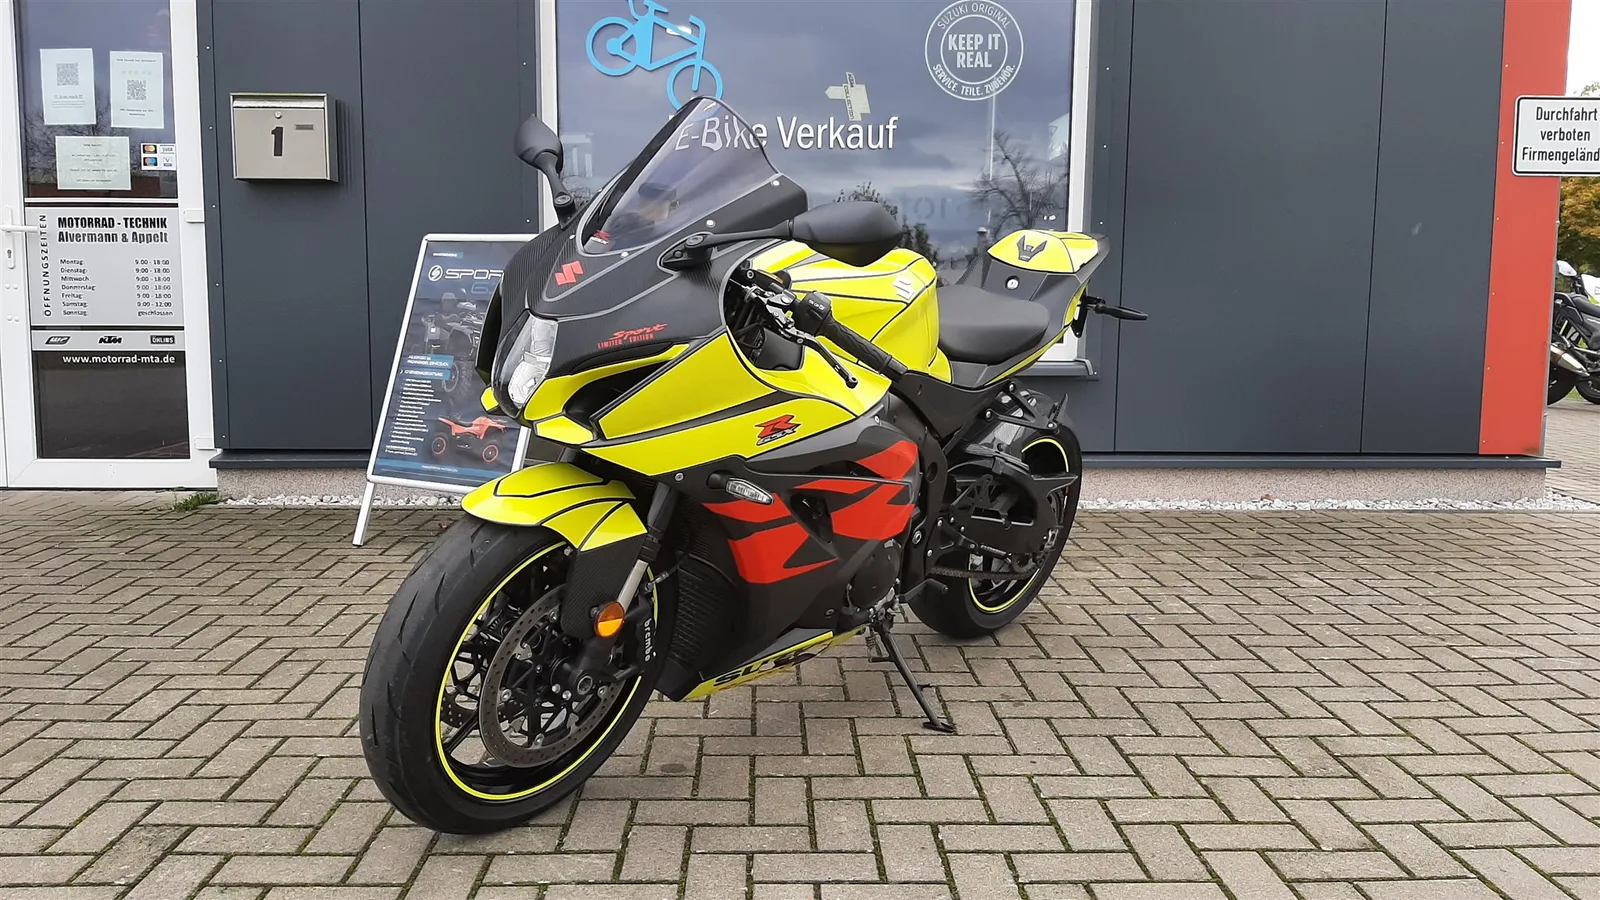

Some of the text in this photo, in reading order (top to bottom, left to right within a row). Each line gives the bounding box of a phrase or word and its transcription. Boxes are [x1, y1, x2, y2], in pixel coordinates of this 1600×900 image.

[937, 3, 1011, 29] SUZUKI ORIGINAL
[948, 33, 1001, 50] KEEP IT
[956, 51, 992, 68] REAL
[1535, 106, 1598, 121] Durchfahrt
[670, 114, 899, 151] E-Bike Verkauf
[1540, 127, 1591, 142] verboten
[270, 126, 284, 157] 1
[1521, 146, 1600, 165] Firmengeländ
[57, 217, 115, 229] MOTORRAD
[122, 217, 168, 229] TECHNIK
[57, 231, 169, 244] Alvermann & Appelt
[39, 214, 52, 317] ÖFFNUNGSZEITEN
[445, 268, 504, 281] SPOR
[98, 335, 122, 344] KTM
[62, 354, 175, 364] www.motorrad-mta.de
[644, 617, 653, 662] brembo
